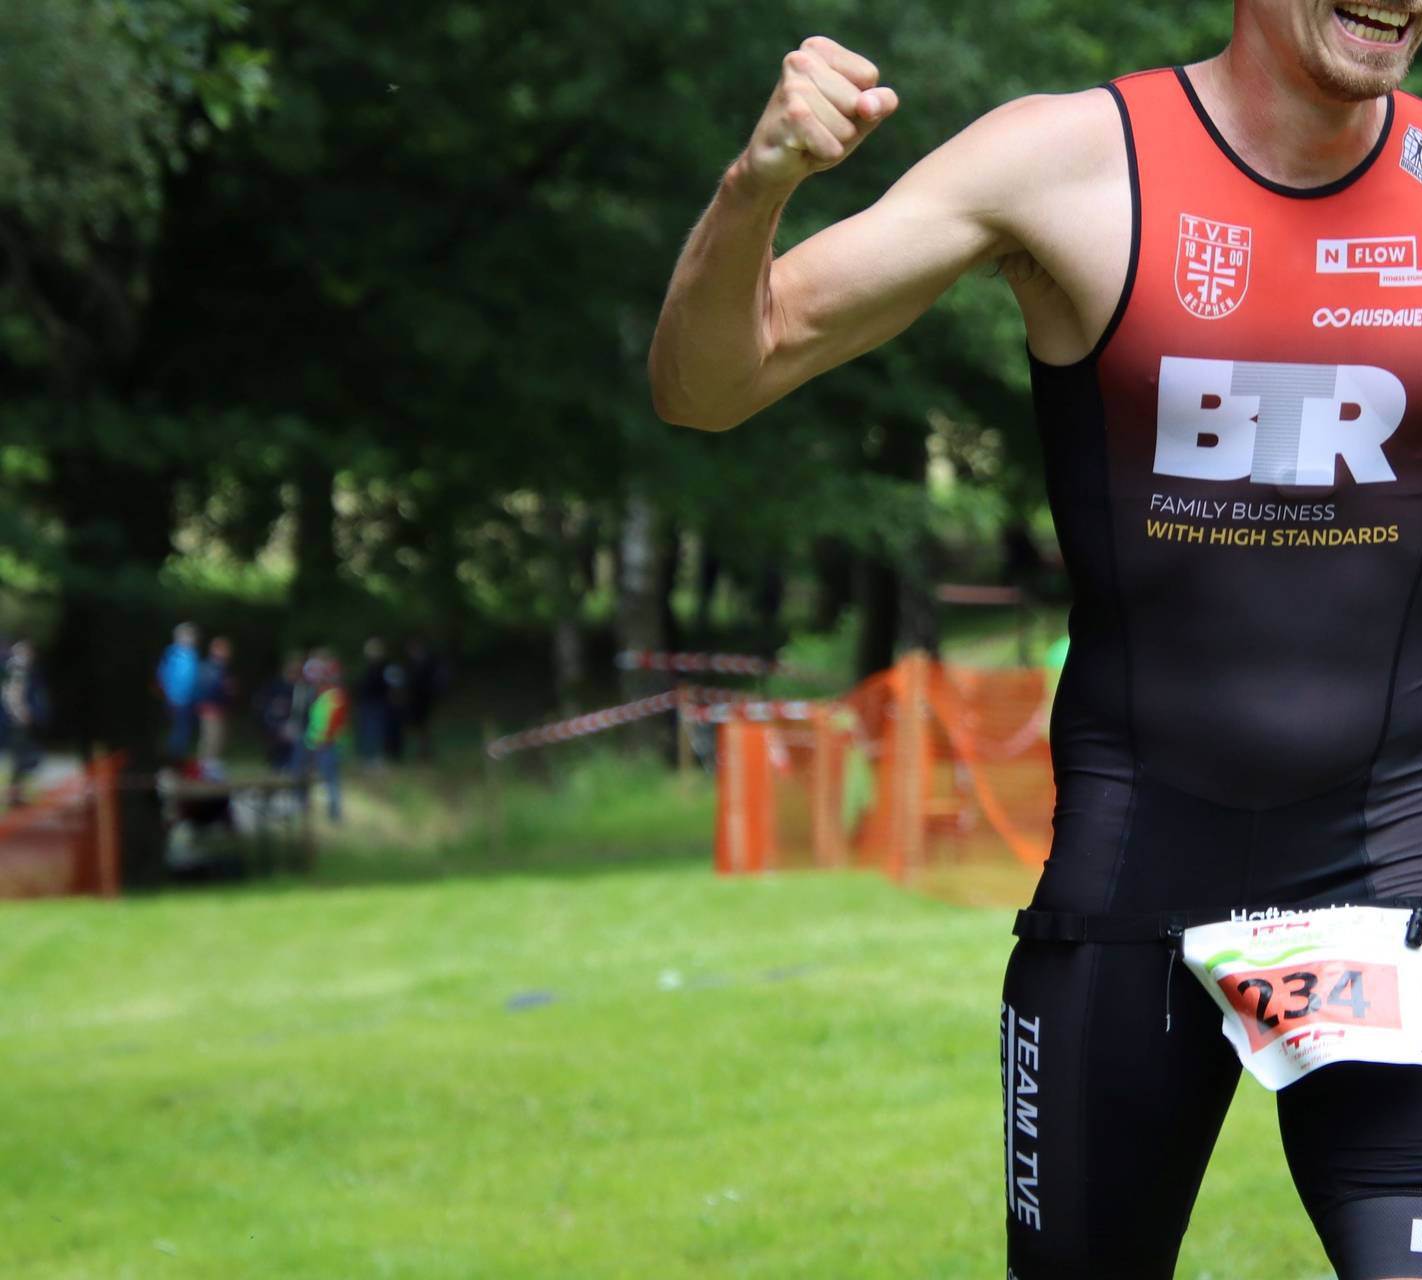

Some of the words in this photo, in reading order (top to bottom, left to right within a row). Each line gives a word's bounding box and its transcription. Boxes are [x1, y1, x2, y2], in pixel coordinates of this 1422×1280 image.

[1185, 217, 1248, 247] T.V.E.
[1185, 240, 1196, 258] 19
[1229, 249, 1243, 266] 00
[1324, 248, 1339, 264] N
[1355, 246, 1406, 264] FLOW
[1153, 356, 1407, 486] BTR
[1150, 494, 1227, 520] FAMILY
[1231, 502, 1335, 521] BUSINESS
[1146, 519, 1204, 543] WITH
[1209, 527, 1266, 546] HIGH
[1271, 524, 1399, 546] STANDARDS
[1236, 970, 1371, 1034] 234
[1016, 1016, 1041, 1139] TEAM
[1016, 1152, 1042, 1232] TVE
